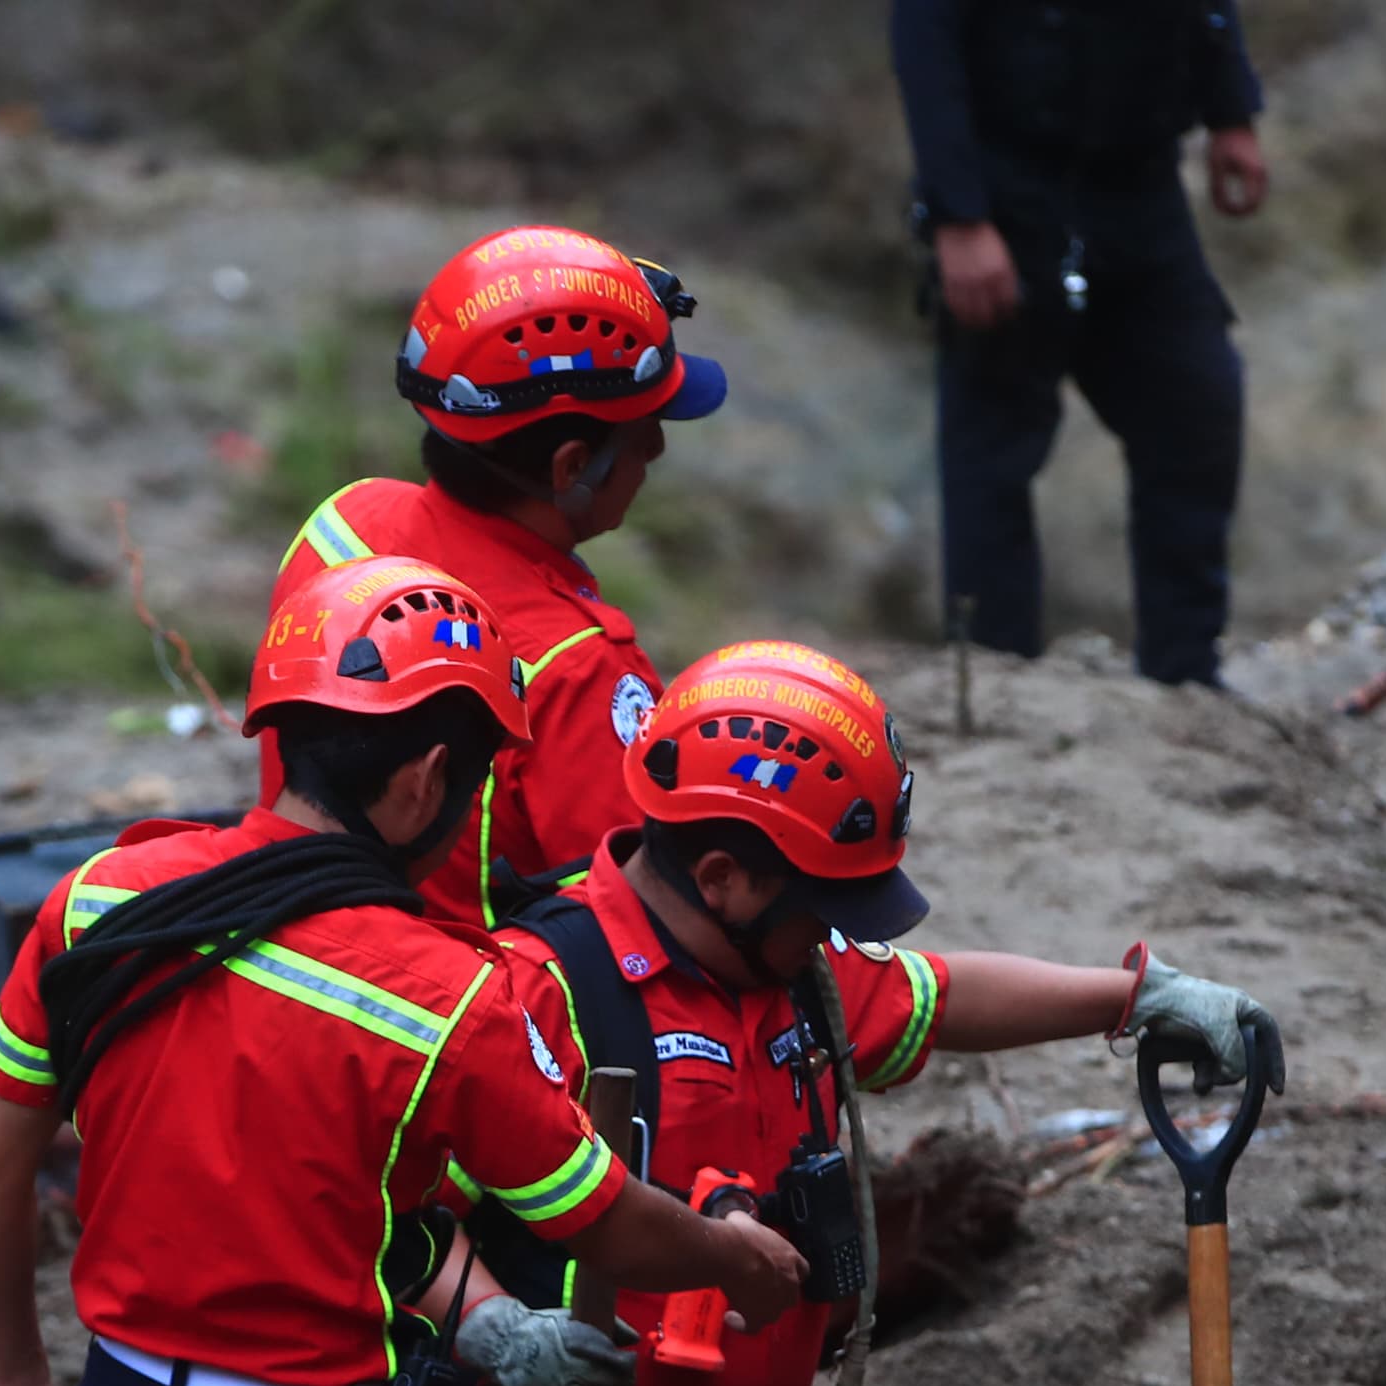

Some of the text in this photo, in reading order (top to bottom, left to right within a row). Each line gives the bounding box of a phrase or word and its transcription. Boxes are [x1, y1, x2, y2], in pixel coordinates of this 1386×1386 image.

[455, 269, 542, 332] BOMBERS
[717, 641, 877, 709] RESCATISTA
[678, 677, 770, 712] BOMBEROS
[773, 684, 877, 758] MUNICIPALES
